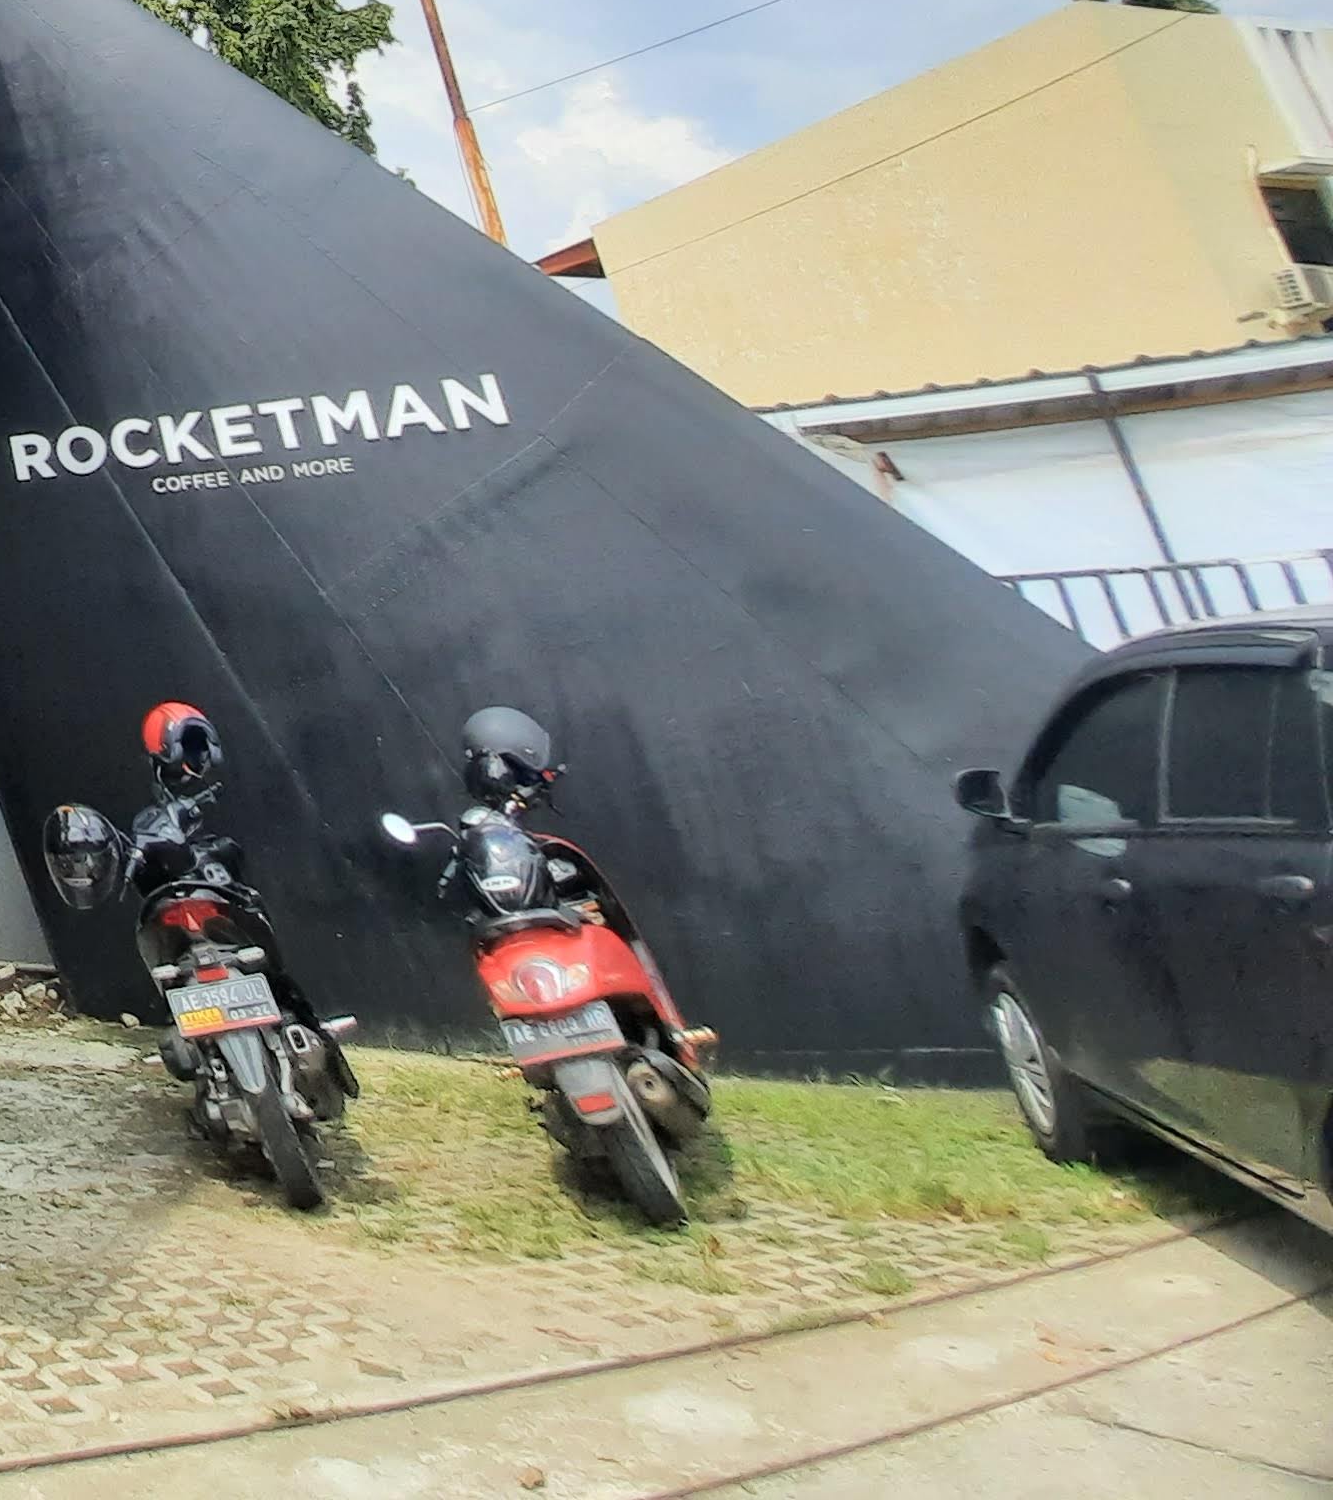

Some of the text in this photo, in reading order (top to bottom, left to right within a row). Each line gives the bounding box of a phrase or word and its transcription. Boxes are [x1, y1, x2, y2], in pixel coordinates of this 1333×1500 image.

[8, 372, 511, 482] ROCKETMAN
[151, 455, 356, 495] COFFEE AND MORE
[178, 995, 202, 1011] AE
[201, 986, 239, 1009] 3594
